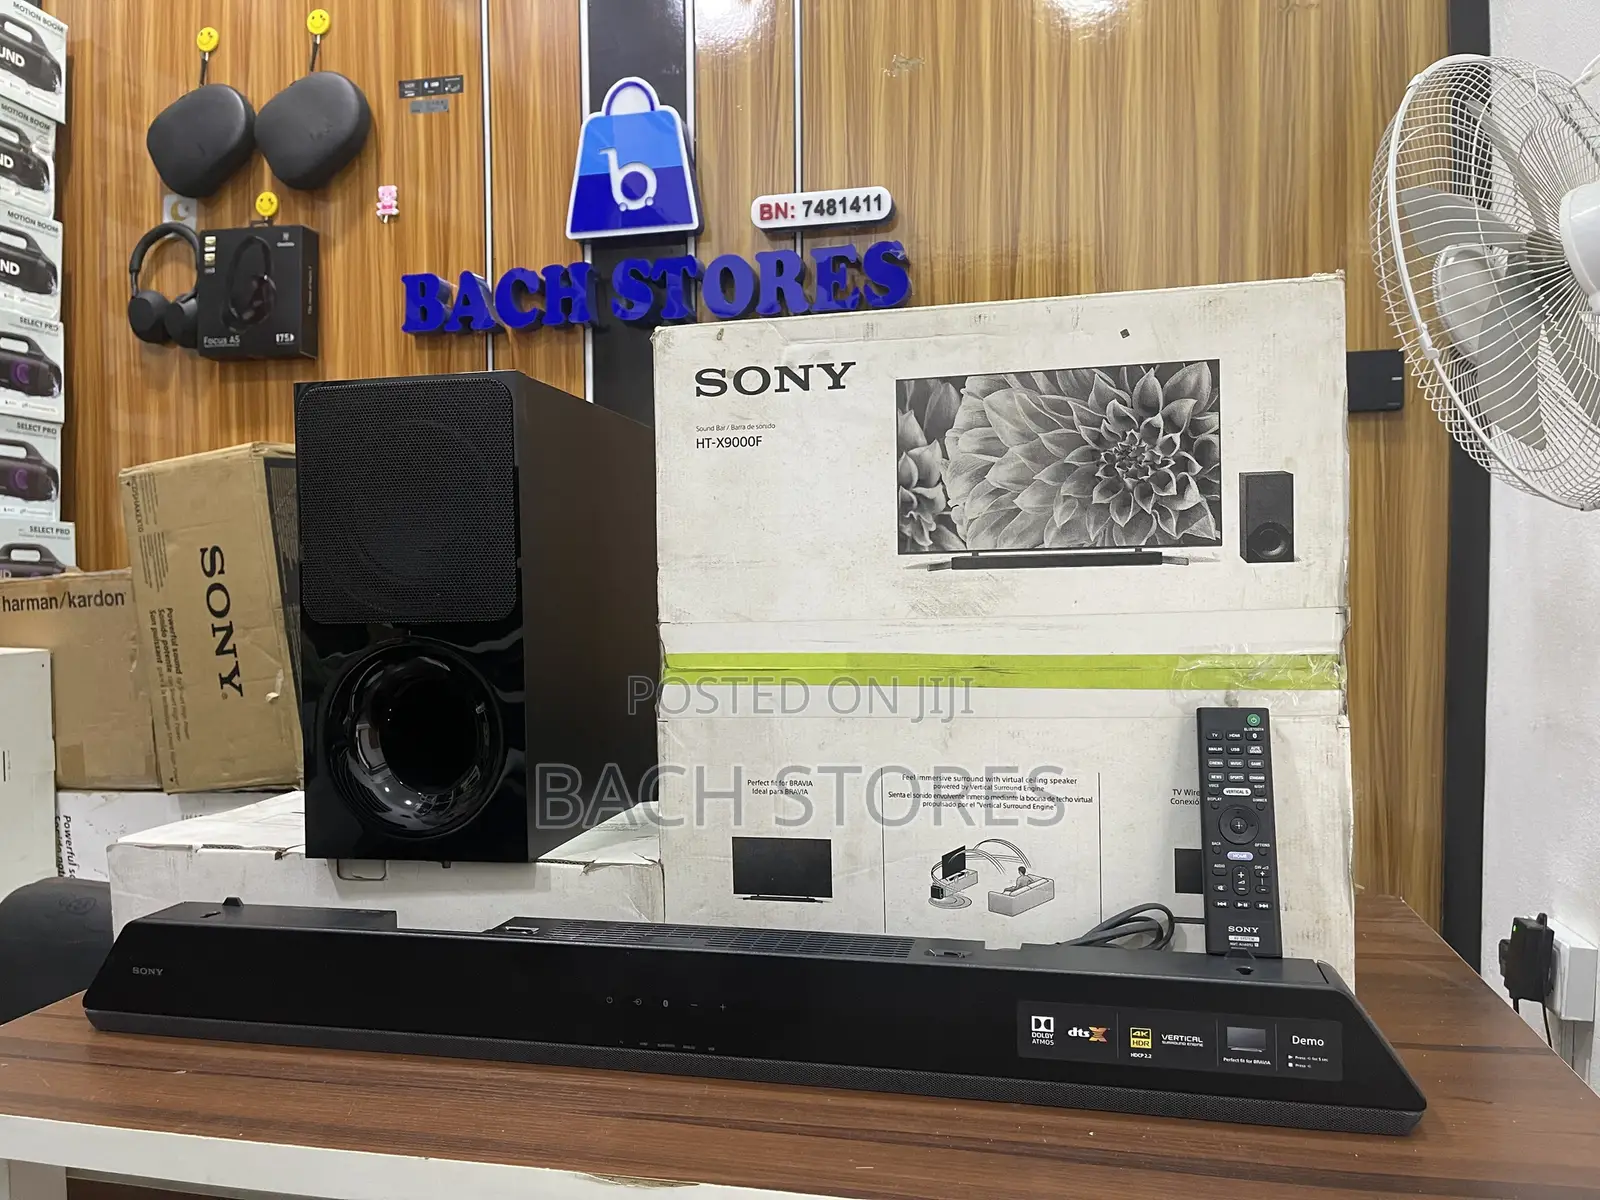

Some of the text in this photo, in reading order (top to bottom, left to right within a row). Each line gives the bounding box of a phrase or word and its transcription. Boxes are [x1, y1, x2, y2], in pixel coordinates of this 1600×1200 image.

[13, 1, 41, 21] MOTION
[42, 16, 64, 32] BOOM
[1, 103, 29, 121] MOTION
[29, 116, 50, 130] BOOM
[759, 193, 882, 221] BN: 7481411
[7, 210, 36, 225] MOTION
[37, 220, 59, 232] BOOM
[402, 261, 597, 332] BACH
[612, 240, 911, 322] STORES
[20, 316, 42, 328] SELECT
[44, 321, 59, 331] PRO
[695, 361, 857, 397] SONY
[17, 421, 41, 432] SELECT
[42, 426, 57, 435] PRO
[696, 424, 715, 432] Sound
[730, 423, 747, 431] Barra
[756, 422, 776, 430] sonido
[696, 435, 762, 449] HT-X9000F
[30, 525, 54, 534] SELECT
[2, 590, 125, 612] harman/kardon
[166, 607, 179, 647] Powerful
[200, 545, 243, 697] SONY
[160, 639, 172, 673] potente
[172, 648, 183, 674] sound
[902, 773, 916, 781] Feel
[917, 774, 952, 782] immersive
[1025, 776, 1048, 785] ceiling
[888, 791, 906, 799] Sienta
[1056, 795, 1074, 803] techo
[1172, 788, 1182, 796] TV
[63, 814, 79, 867] Powerful
[1228, 925, 1259, 934] SONY
[132, 966, 164, 976] SONY
[1161, 1034, 1203, 1043] VERTICAL
[1292, 1035, 1325, 1047] Demo
